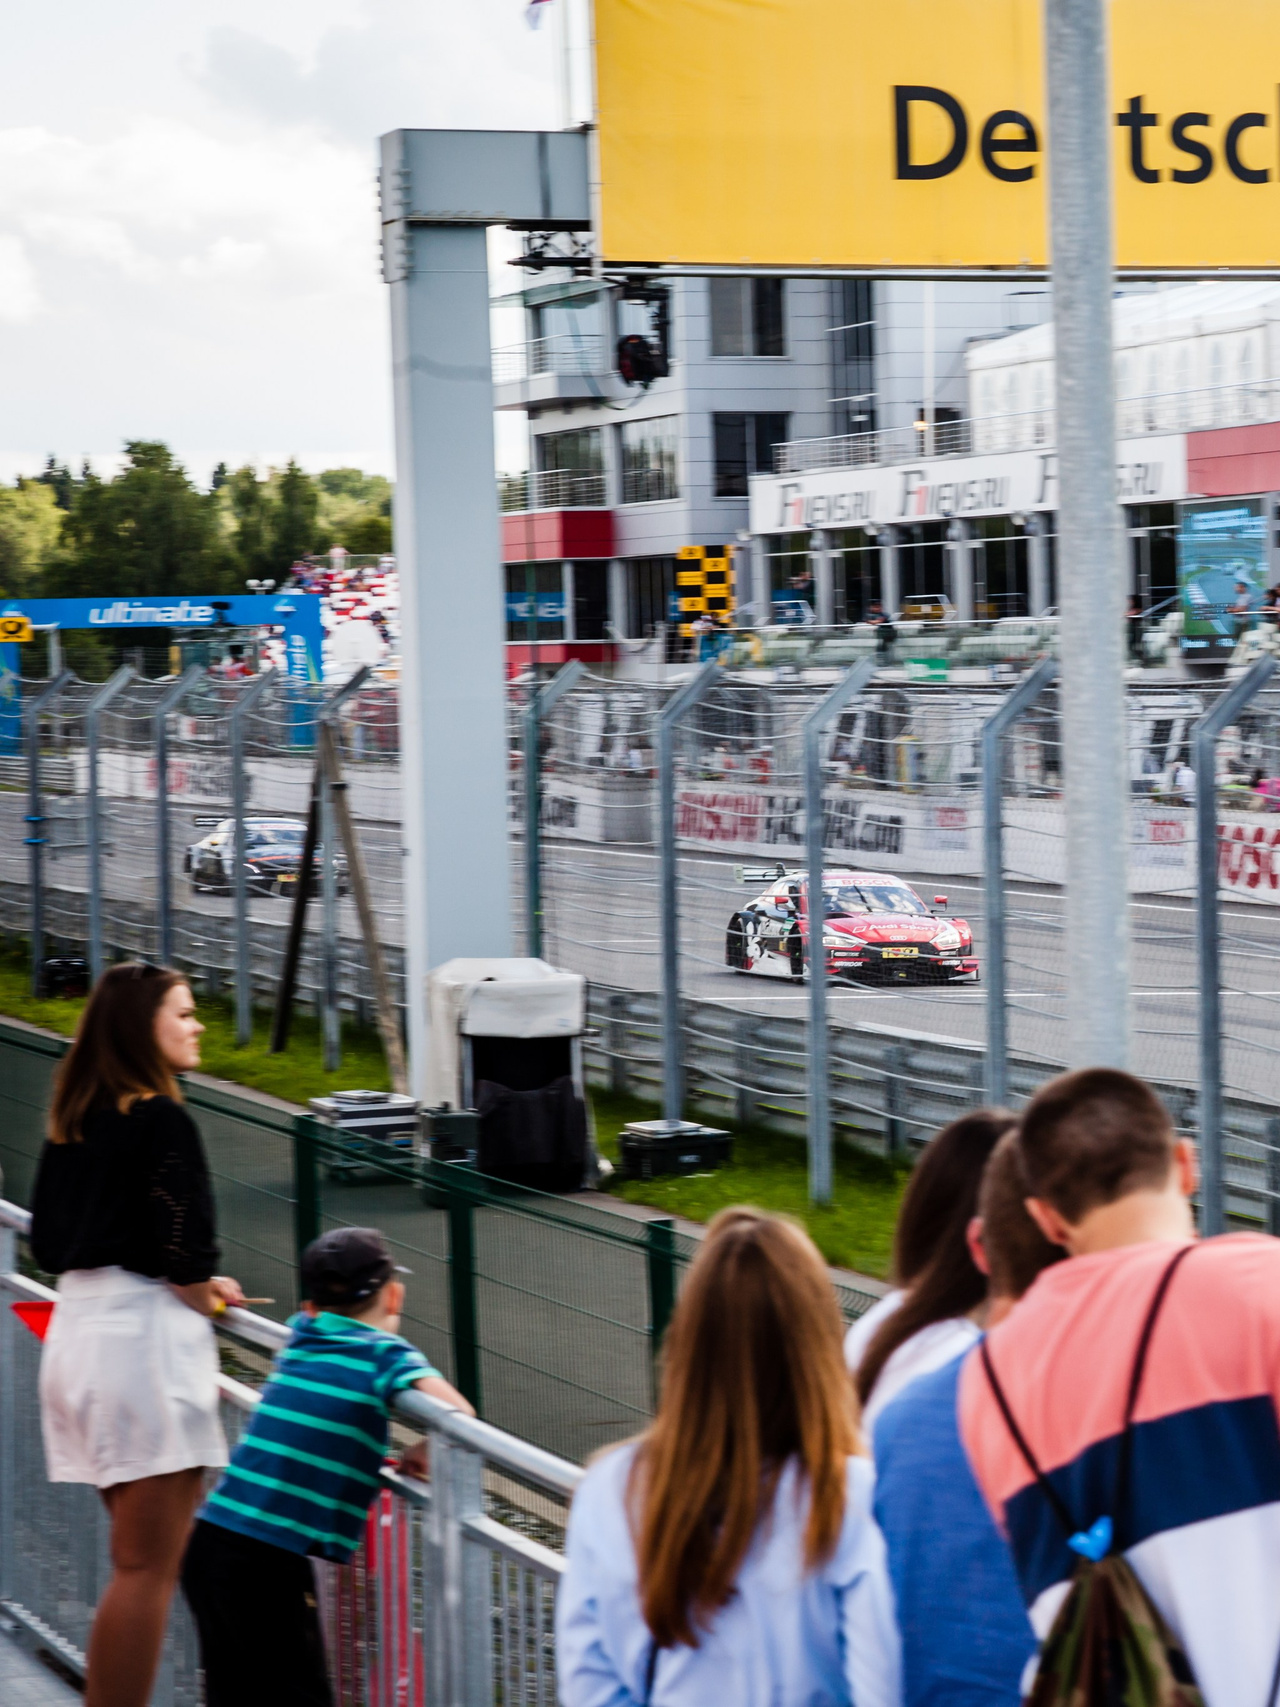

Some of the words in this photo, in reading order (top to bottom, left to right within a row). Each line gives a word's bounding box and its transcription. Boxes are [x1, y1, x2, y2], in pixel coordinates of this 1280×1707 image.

[88, 600, 214, 624] ultimate
[842, 879, 894, 887] BOSCH
[868, 923, 899, 931] Audi
[900, 923, 937, 933] Sport
